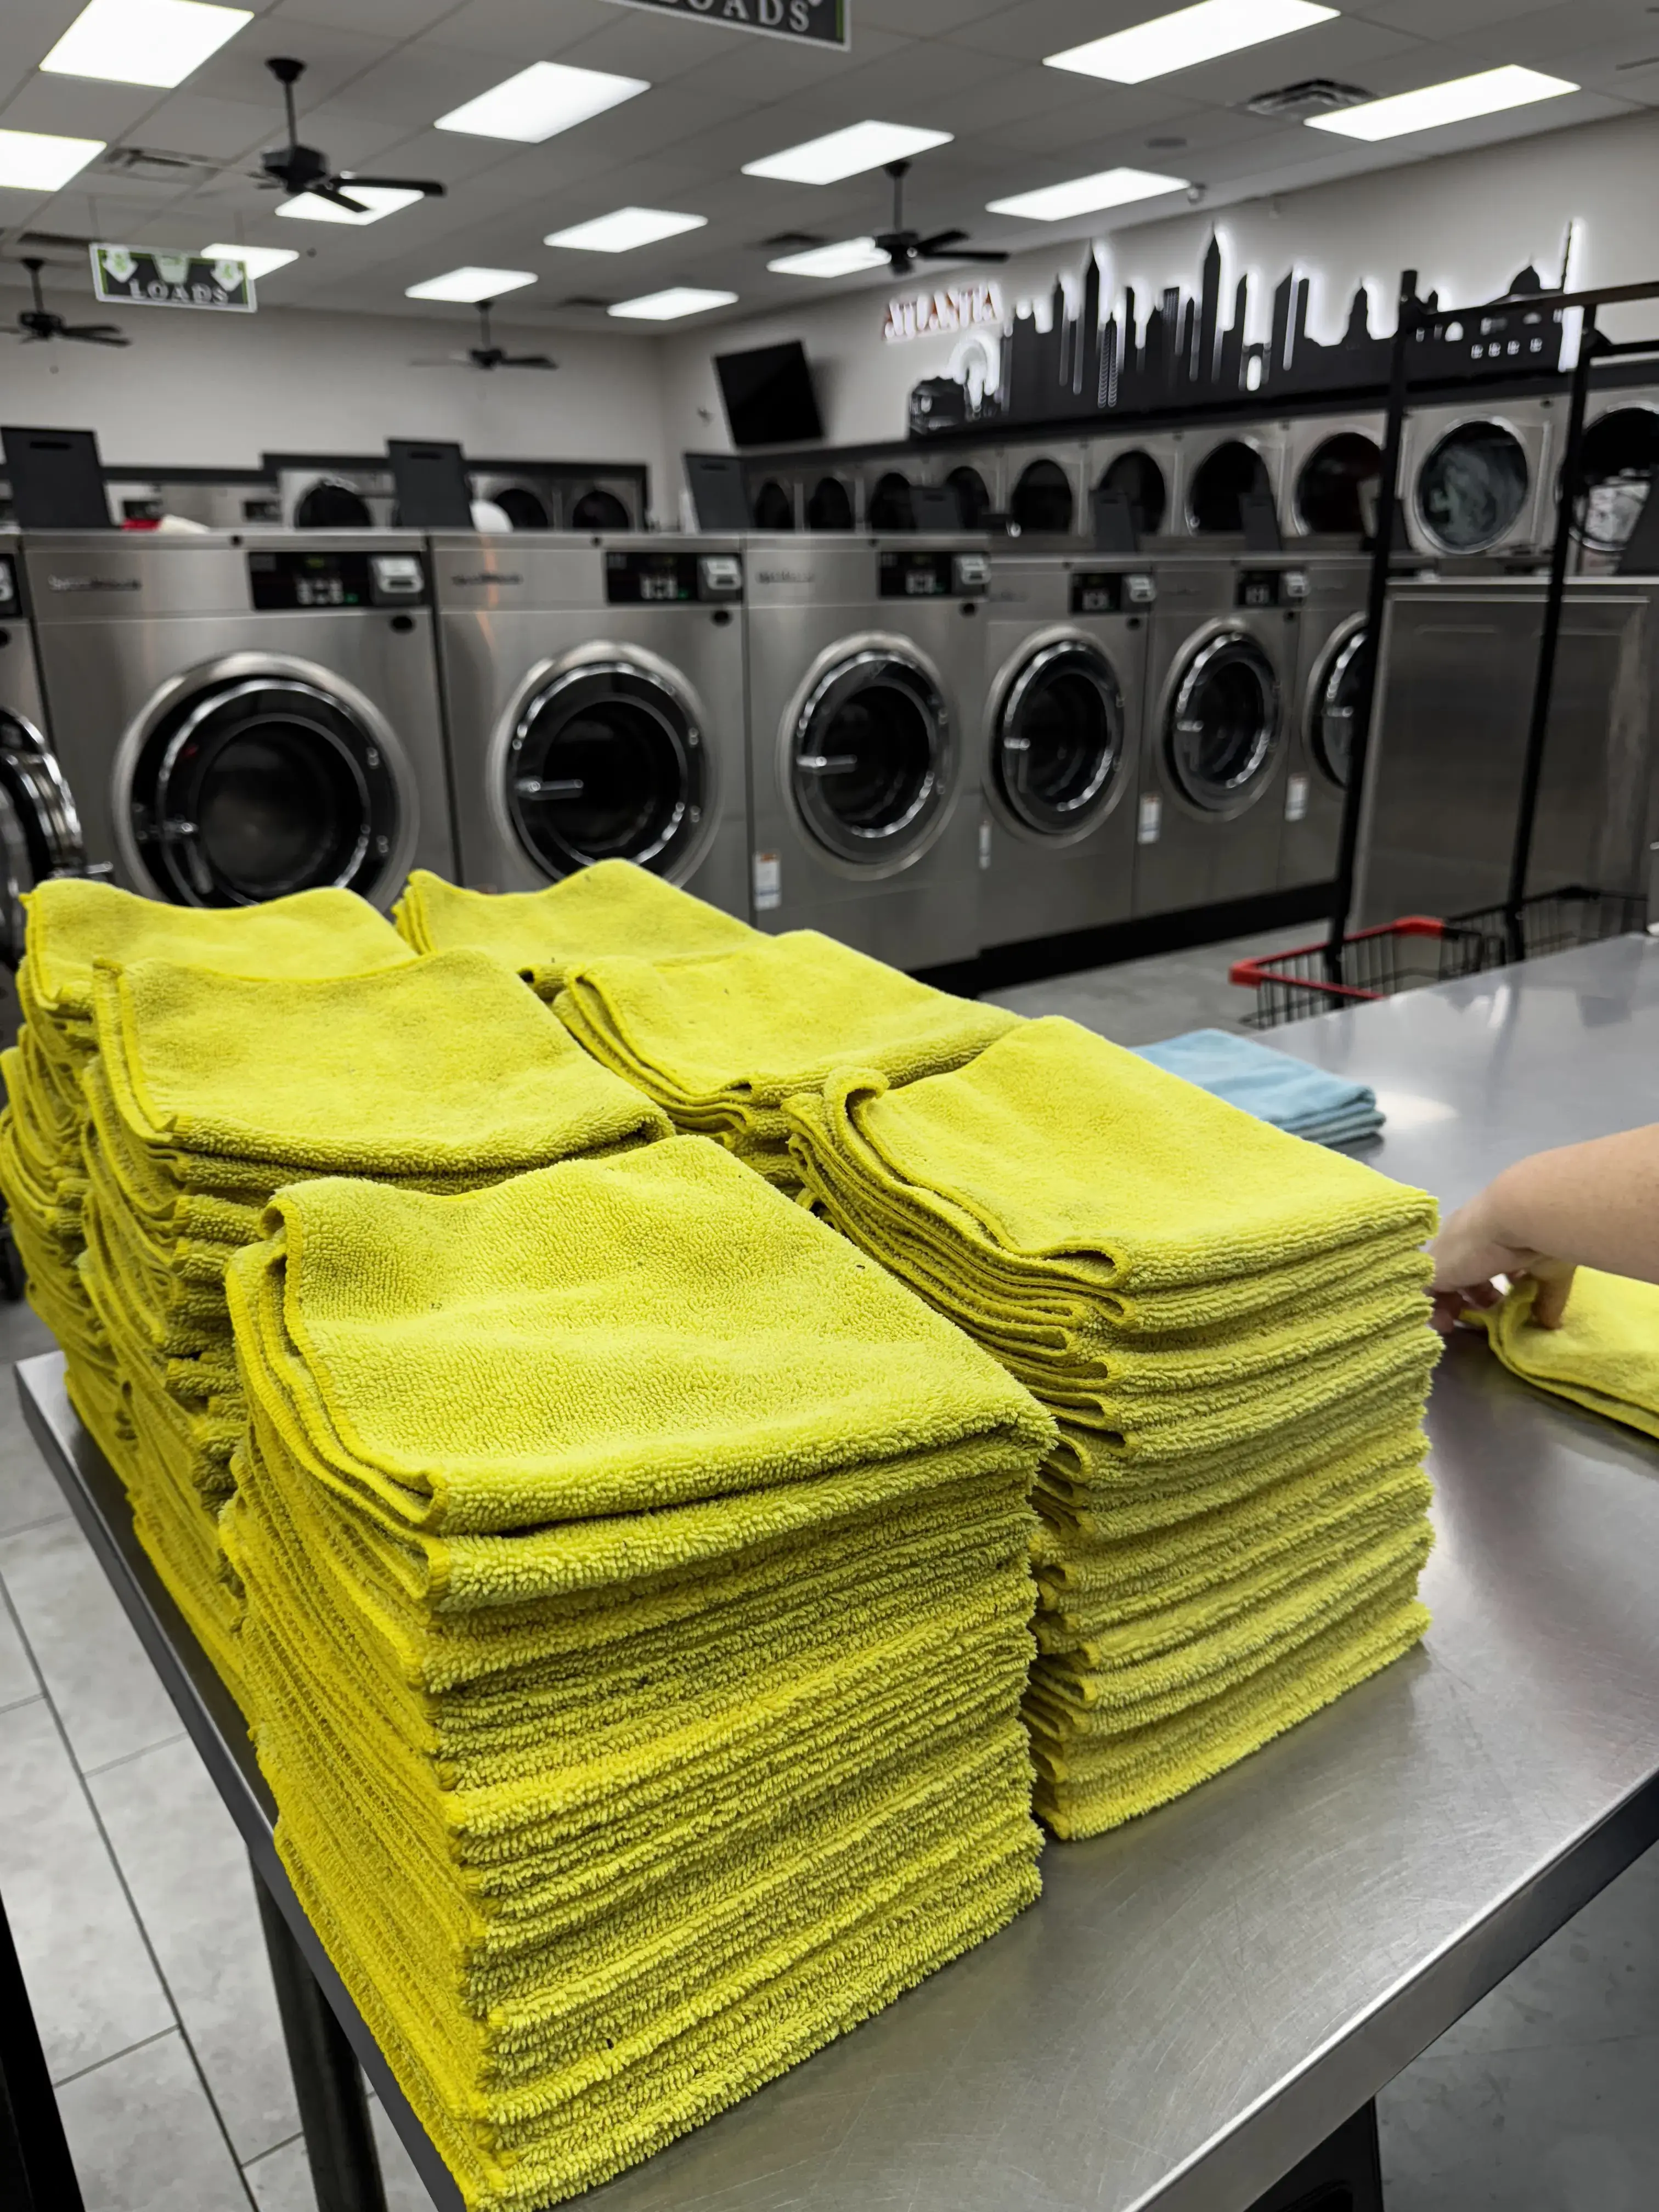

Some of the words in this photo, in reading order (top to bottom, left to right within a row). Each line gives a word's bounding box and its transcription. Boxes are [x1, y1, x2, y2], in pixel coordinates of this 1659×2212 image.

[662, 0, 810, 32] ADS
[129, 279, 229, 306] LOADS
[882, 281, 1003, 341] ATLANTA
